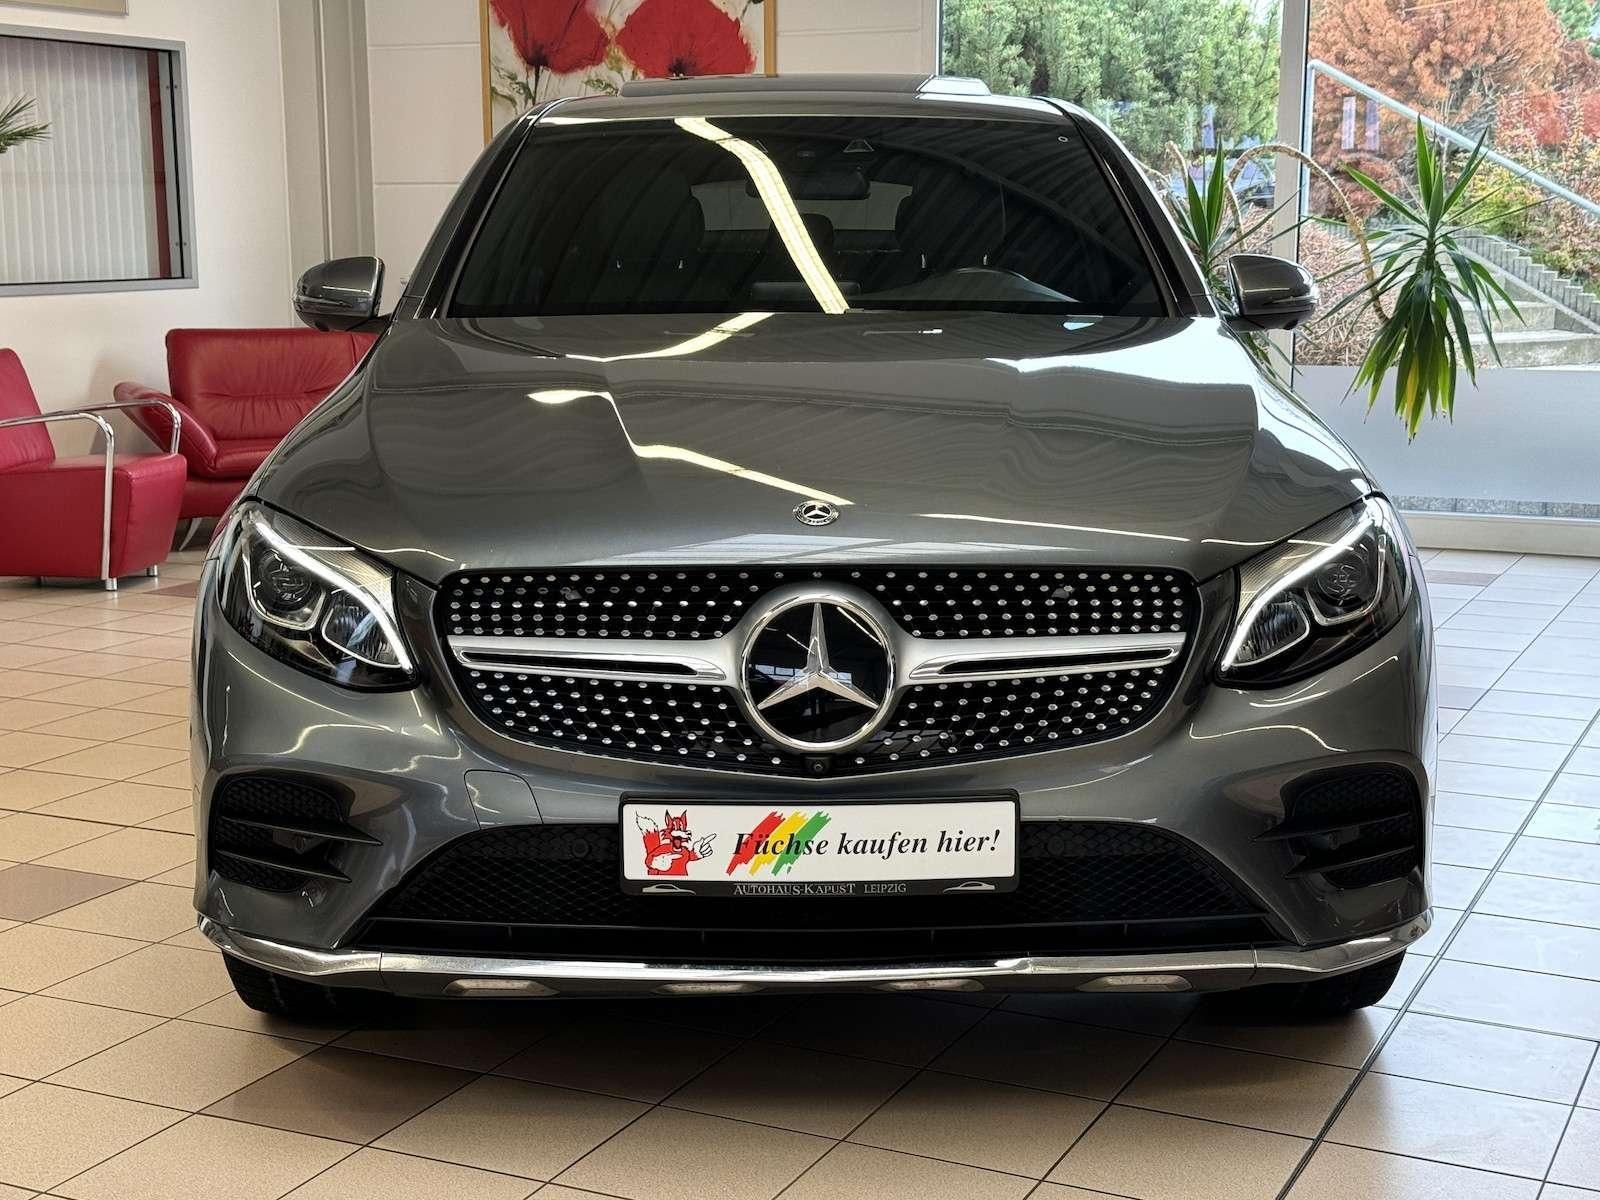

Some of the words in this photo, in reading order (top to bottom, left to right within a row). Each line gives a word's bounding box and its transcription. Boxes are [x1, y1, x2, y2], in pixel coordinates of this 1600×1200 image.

[732, 832, 829, 855] Füchse
[837, 831, 928, 860] kaufen
[936, 829, 1001, 853] hier!
[863, 883, 907, 894] LEIPZIG
